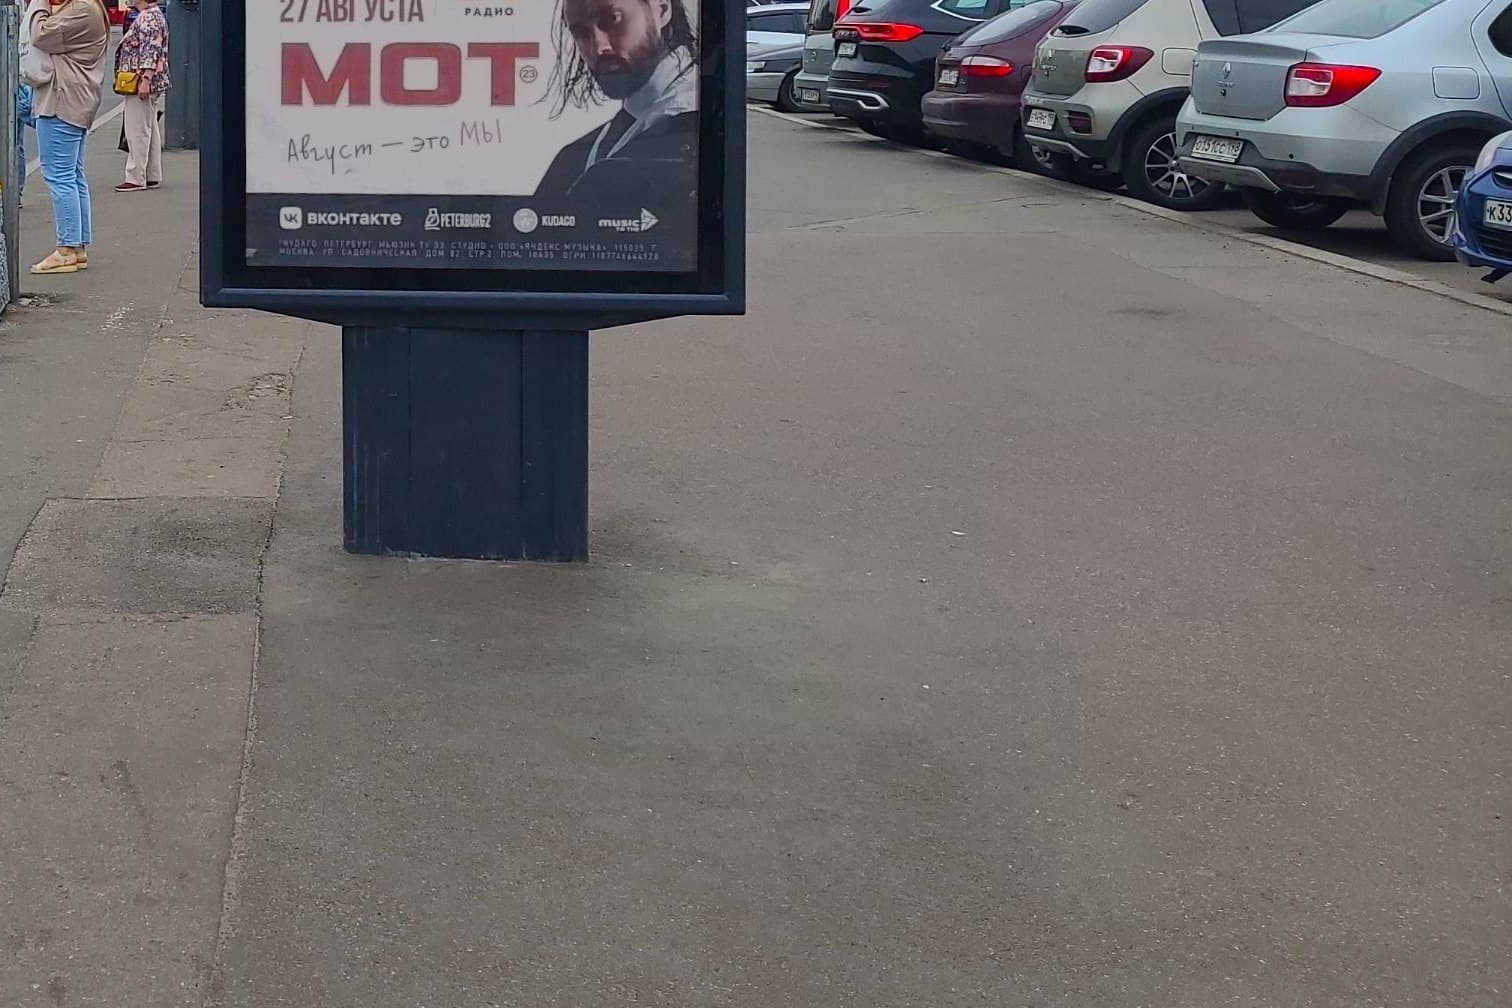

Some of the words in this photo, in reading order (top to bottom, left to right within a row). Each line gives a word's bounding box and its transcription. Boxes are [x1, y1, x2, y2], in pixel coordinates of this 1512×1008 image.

[464, 7, 514, 18] РАДИО
[280, 42, 540, 108] МОТ
[288, 134, 372, 175] Август
[410, 136, 450, 153] это
[460, 120, 502, 146] МЫ
